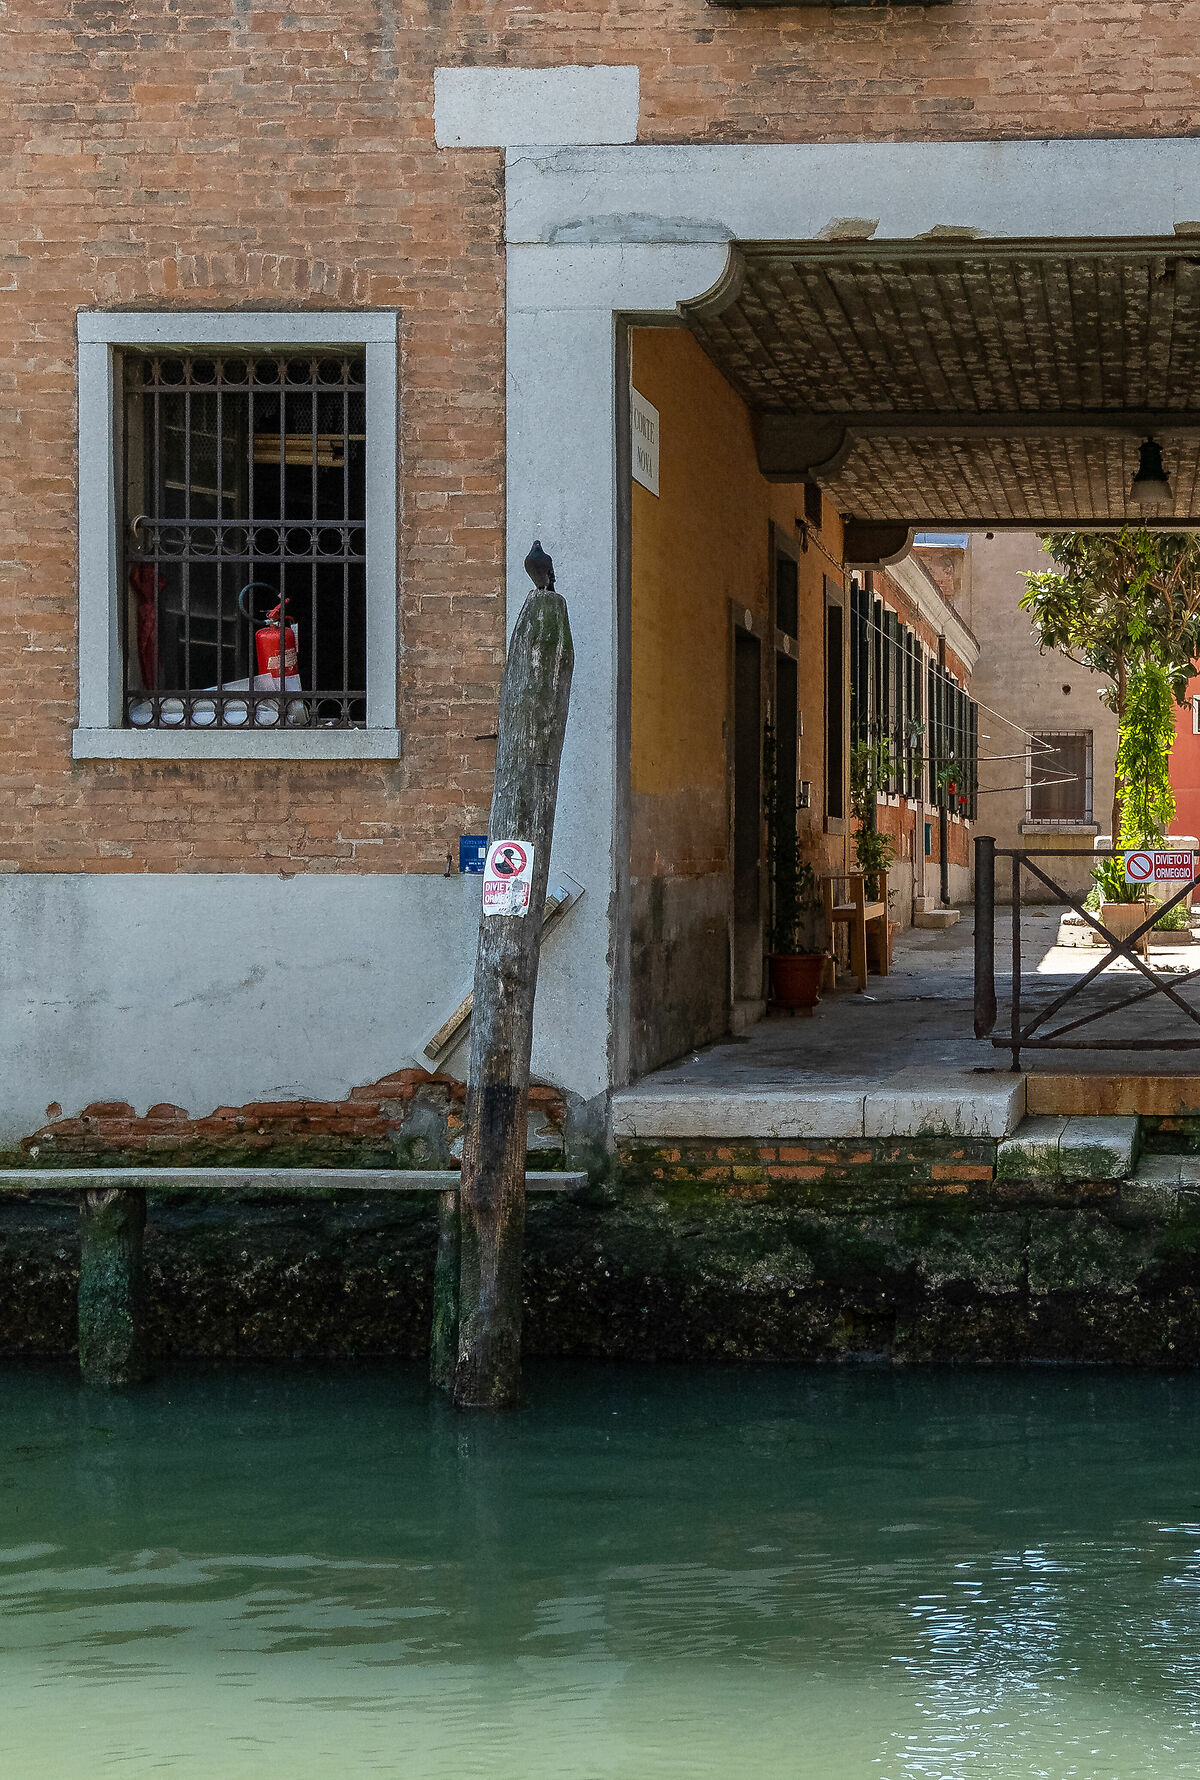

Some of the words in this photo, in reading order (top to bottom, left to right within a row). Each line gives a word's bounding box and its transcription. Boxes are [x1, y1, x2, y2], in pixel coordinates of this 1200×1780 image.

[634, 408, 655, 444] CORTE
[637, 445, 653, 479] NOVA
[1155, 854, 1182, 865] DIVIETO
[1183, 854, 1191, 865] DI
[1156, 867, 1191, 878] ORMEGGIO
